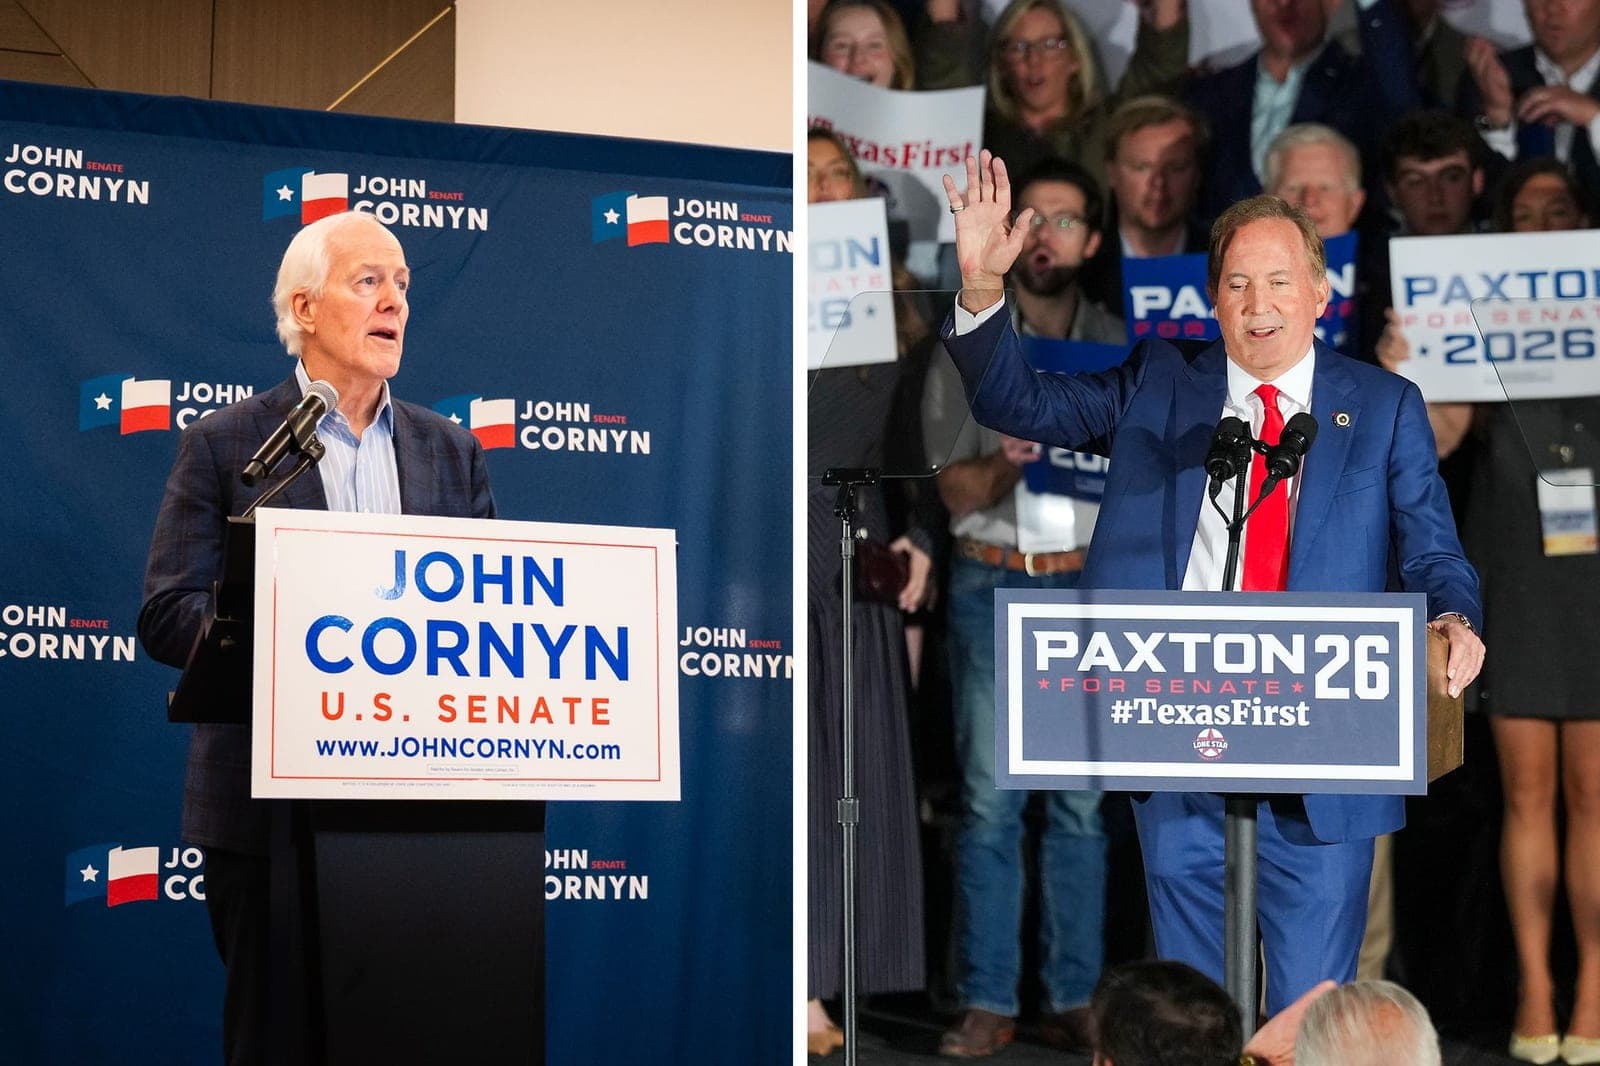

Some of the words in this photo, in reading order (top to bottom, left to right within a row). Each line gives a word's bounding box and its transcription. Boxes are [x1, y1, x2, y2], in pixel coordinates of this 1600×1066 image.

[5, 144, 83, 169] JOHN
[86, 161, 124, 173] SENATE
[4, 169, 150, 205] CORNYN
[353, 175, 426, 198] JOHN
[429, 191, 464, 201] SENATE
[673, 199, 738, 221] JOHN
[740, 213, 772, 224] SENATE
[1403, 269, 1600, 306] PAXTO
[1443, 328, 1596, 365] 2026
[176, 381, 253, 404] JOHN
[520, 400, 590, 422] JOHN
[593, 414, 627, 424] SENATE
[520, 425, 650, 455] CORNYN
[374, 550, 564, 607] JOHN
[2, 605, 66, 628] OHN
[70, 619, 109, 629] SENATE
[305, 615, 630, 681] CORNYN
[680, 626, 746, 648] JOHN
[749, 640, 782, 649] SENATE
[1033, 631, 1305, 674] PAXTON
[1313, 634, 1391, 700] 26
[1061, 677, 1125, 693] FOR
[1145, 679, 1280, 695] SENATE
[321, 692, 411, 723] U.S.
[438, 694, 611, 726] SENATE
[1111, 697, 1310, 727] #TexasFirst
[316, 736, 621, 761] www.JOHNCORNYN.com
[591, 860, 626, 870] SENATE
[545, 875, 649, 900] ORNYN
